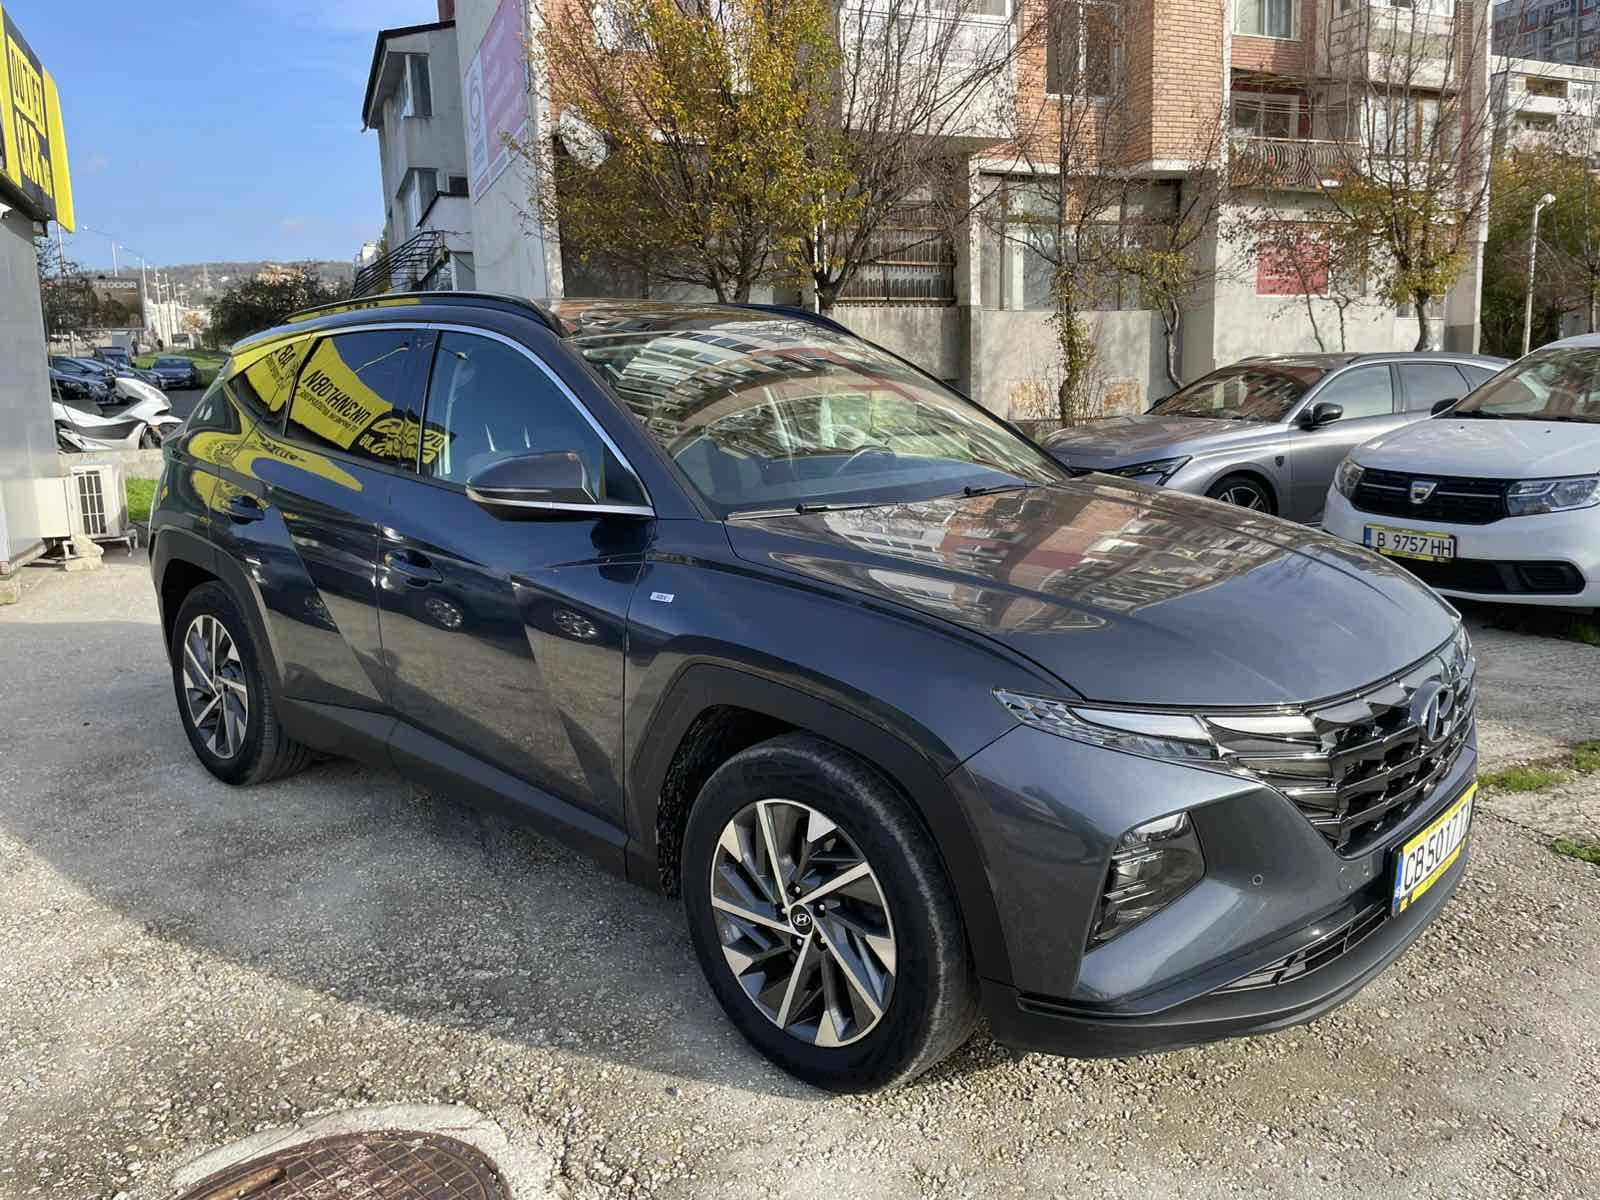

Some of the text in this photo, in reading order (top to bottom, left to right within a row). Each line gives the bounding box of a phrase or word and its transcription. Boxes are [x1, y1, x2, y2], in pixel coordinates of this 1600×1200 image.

[10, 50, 44, 128] OUTLET
[1377, 532, 1452, 556] B 9757 HH
